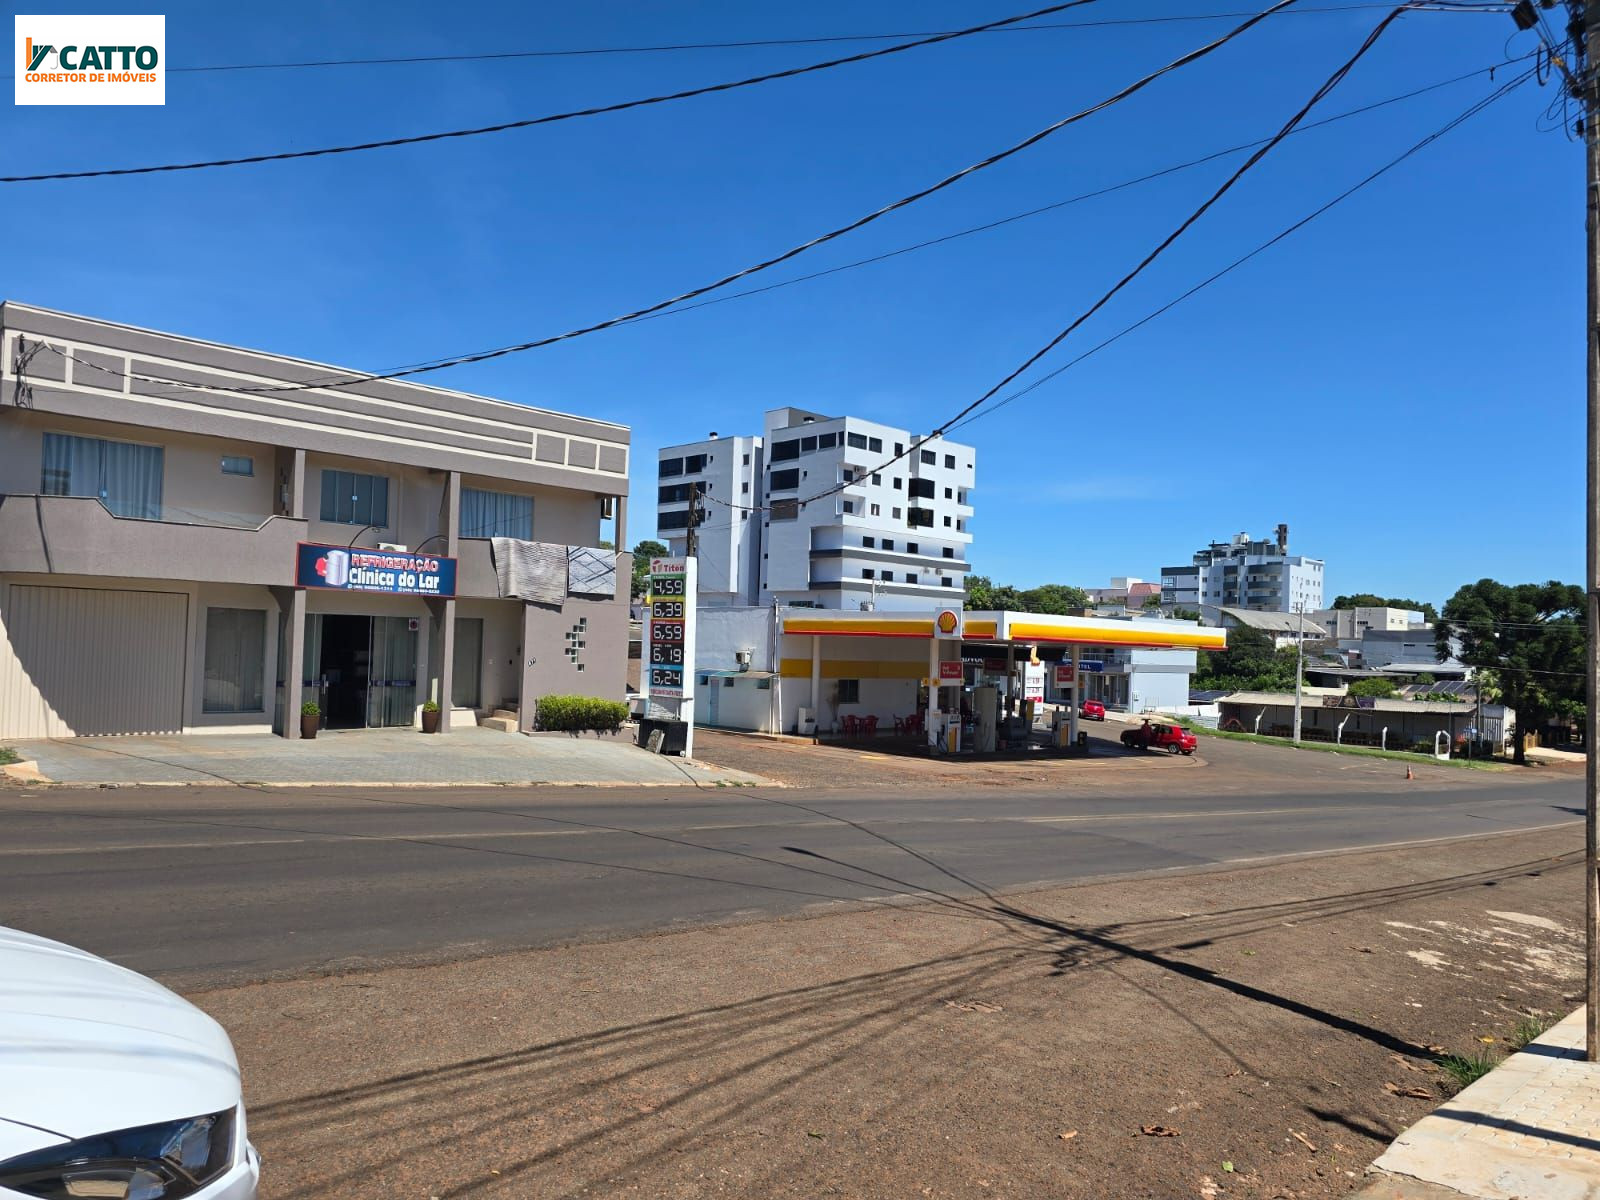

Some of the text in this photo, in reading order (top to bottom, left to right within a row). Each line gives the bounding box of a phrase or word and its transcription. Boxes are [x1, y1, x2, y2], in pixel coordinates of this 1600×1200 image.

[351, 553, 439, 573] REFRIGERAÇÃO
[349, 567, 440, 589] Clínica do Lar
[654, 580, 683, 594] 4,59
[653, 602, 683, 618] 6,39
[653, 625, 683, 640] 6,59
[653, 648, 682, 663] 6,19
[652, 670, 681, 686] 6,24
